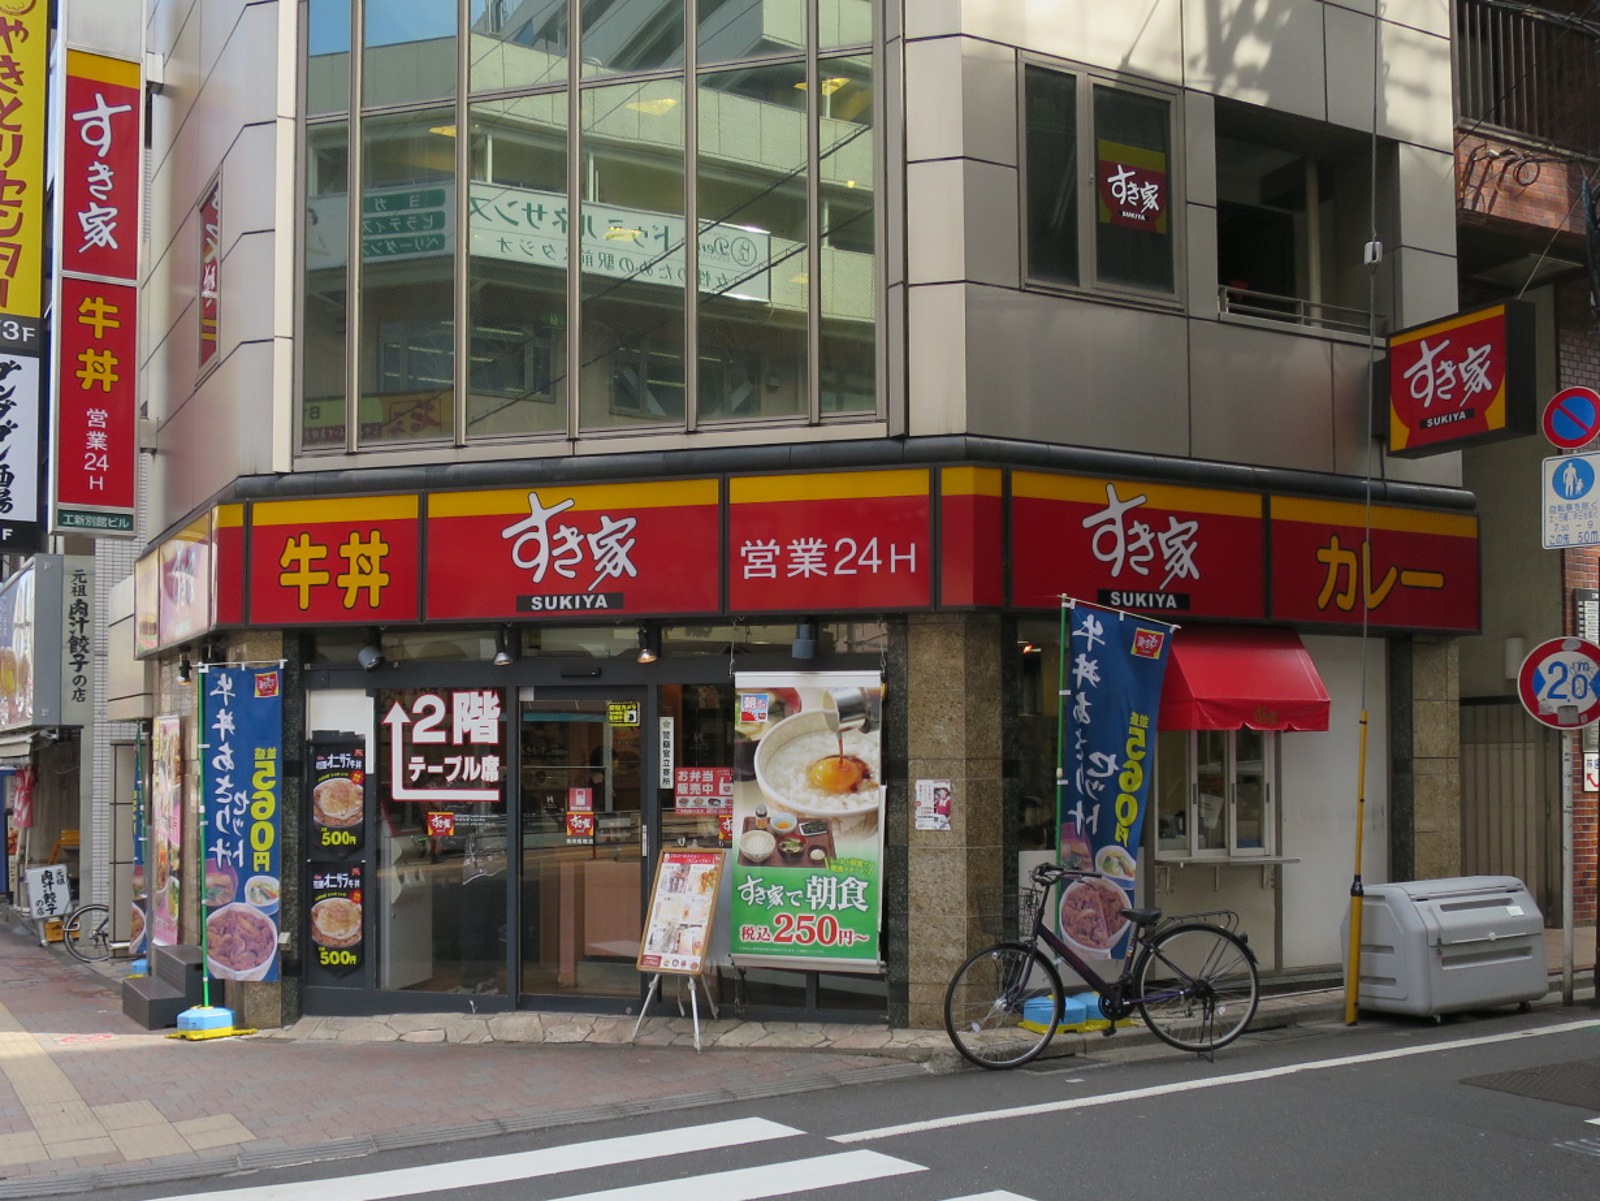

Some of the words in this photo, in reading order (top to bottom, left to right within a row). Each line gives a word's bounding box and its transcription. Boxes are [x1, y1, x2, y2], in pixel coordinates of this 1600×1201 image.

[72, 93, 132, 253] すき家
[1107, 164, 1160, 213] すき家
[1122, 211, 1146, 221] SUKIYA
[75, 297, 120, 393] 牛丼
[1403, 339, 1493, 408] すき家
[1426, 411, 1467, 428] SUKIYA
[84, 408, 109, 490] 営業24H
[502, 491, 637, 592] すき家
[1082, 483, 1201, 590] すき家
[1578, 530, 1598, 543] 50m
[278, 529, 391, 610] 牛丼
[740, 536, 917, 580] 営業24H
[1316, 534, 1446, 612] カレー
[531, 595, 608, 611] SUKIYA
[1110, 591, 1178, 609] SUKIYA
[411, 691, 501, 745] 2階
[408, 755, 500, 783] テーブル席
[677, 770, 714, 782] お弁当
[677, 783, 714, 795] 販売中
[321, 831, 356, 846] 500円
[737, 874, 870, 912] すき家で朝食
[319, 950, 357, 965] 500円
